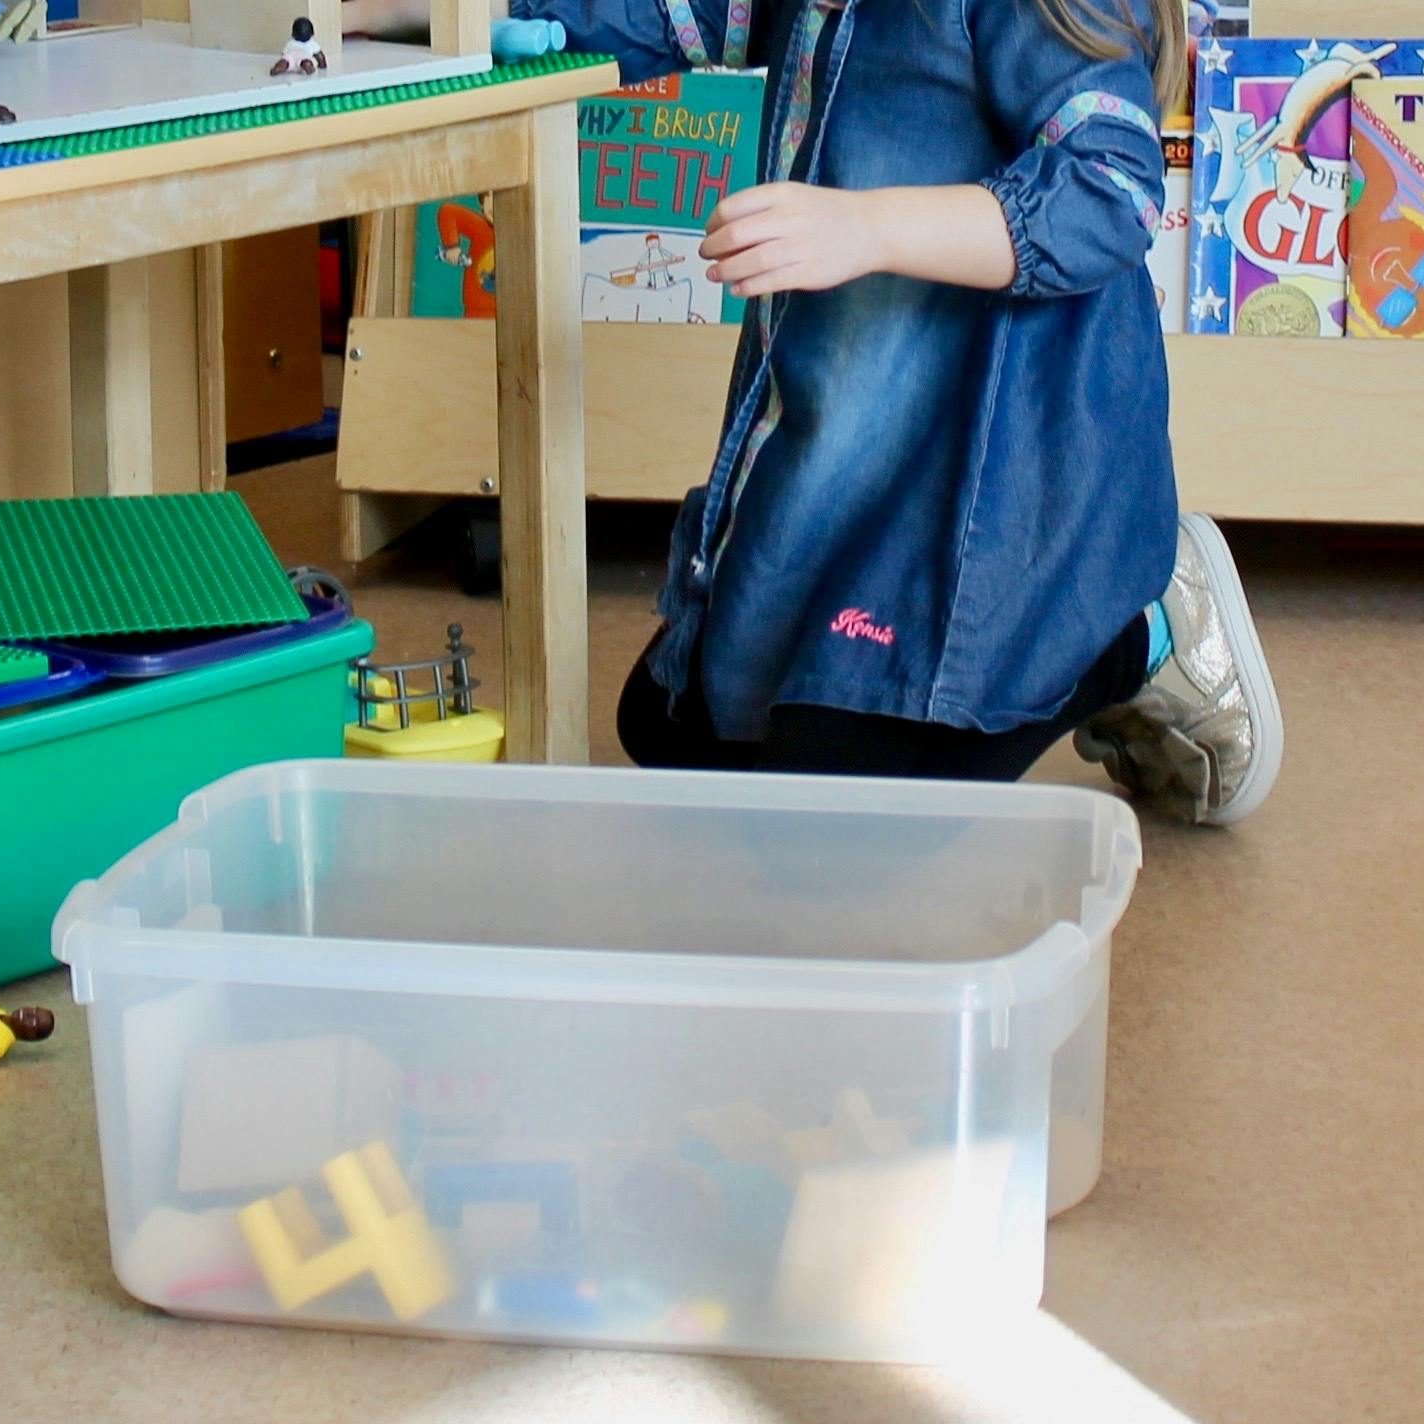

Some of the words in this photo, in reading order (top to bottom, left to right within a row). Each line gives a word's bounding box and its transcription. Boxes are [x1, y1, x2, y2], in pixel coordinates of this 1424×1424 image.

[627, 106, 648, 134] I
[653, 105, 742, 149] BRUSH
[1165, 143, 1187, 157] 20
[1160, 207, 1189, 232] SS
